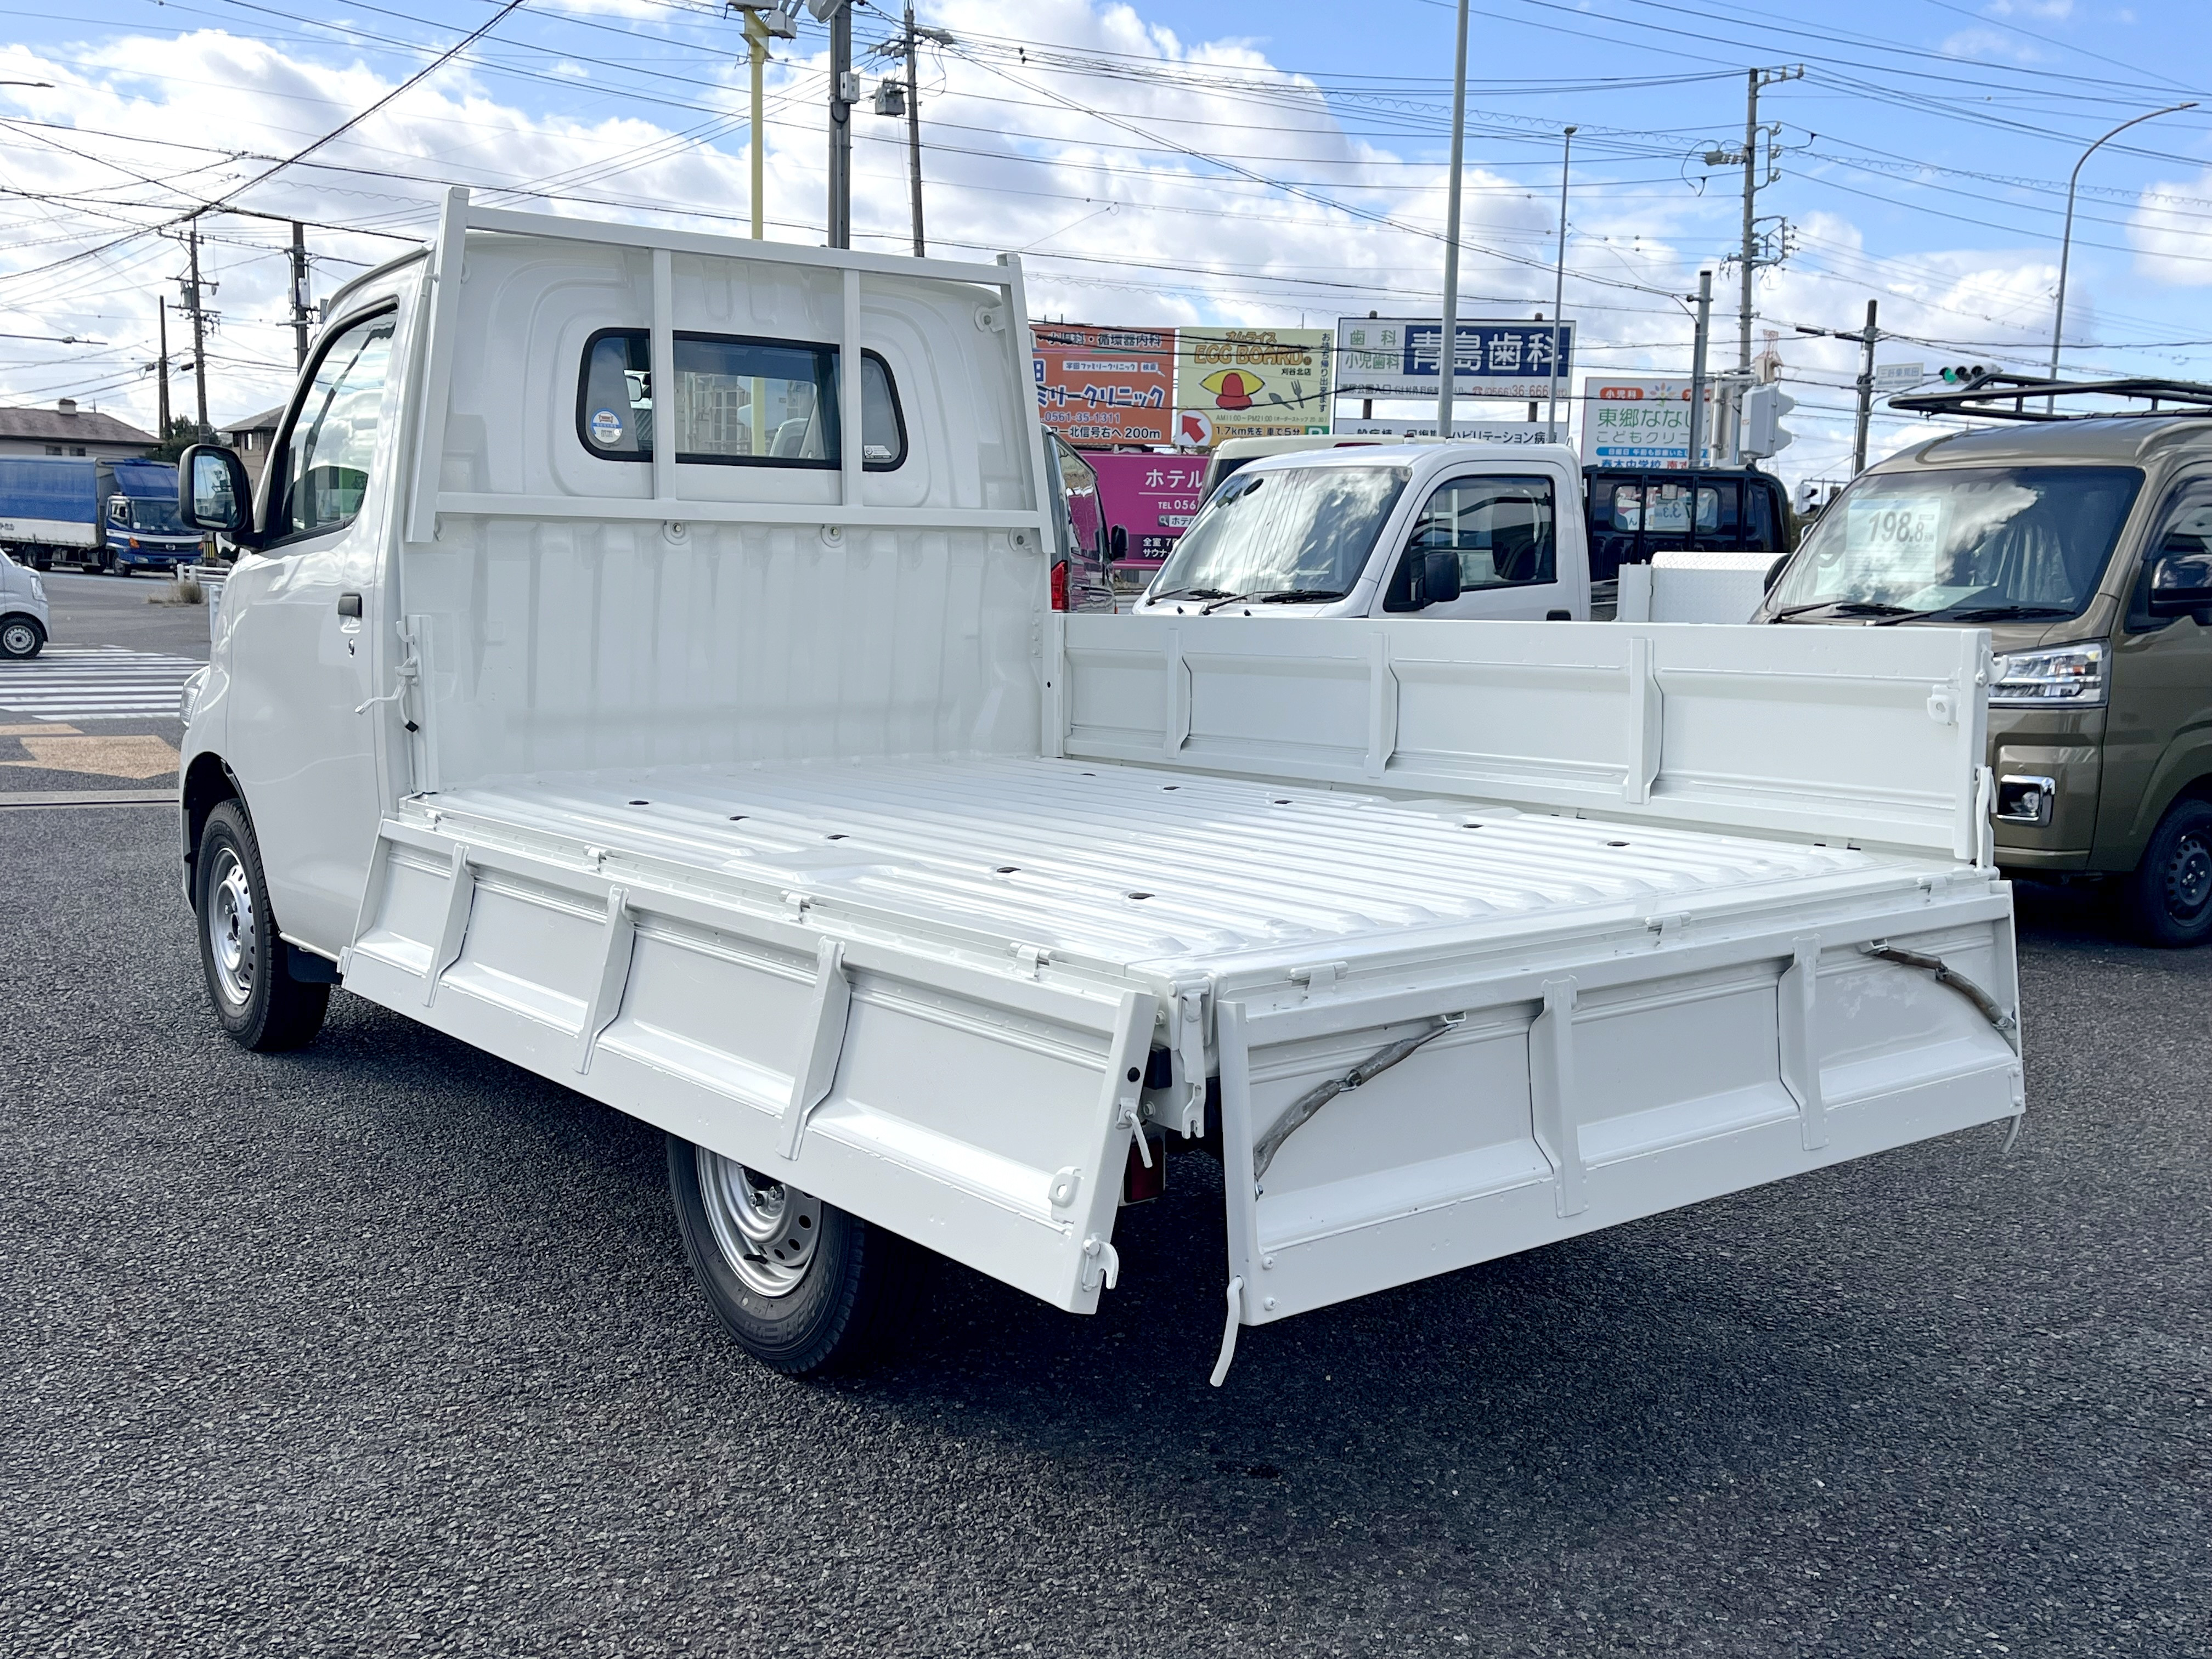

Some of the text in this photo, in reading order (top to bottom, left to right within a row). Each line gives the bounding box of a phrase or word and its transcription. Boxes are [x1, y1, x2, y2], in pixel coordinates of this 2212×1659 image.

[1226, 331, 1277, 343] オムライス
[1194, 344, 1304, 365] EGG BOARD
[1410, 330, 1563, 371] 青島歯科
[1345, 352, 1400, 369] 小児歯科
[1281, 368, 1312, 376] 刈谷北店
[1605, 389, 1637, 399] 小児科
[1125, 428, 1160, 438] 200m
[1145, 469, 1203, 488] ホテル
[1158, 499, 1197, 510] TEL 056
[1869, 511, 1925, 543] 198.8
[1143, 537, 1162, 547] 全室
[1143, 548, 1170, 558] サウナ
